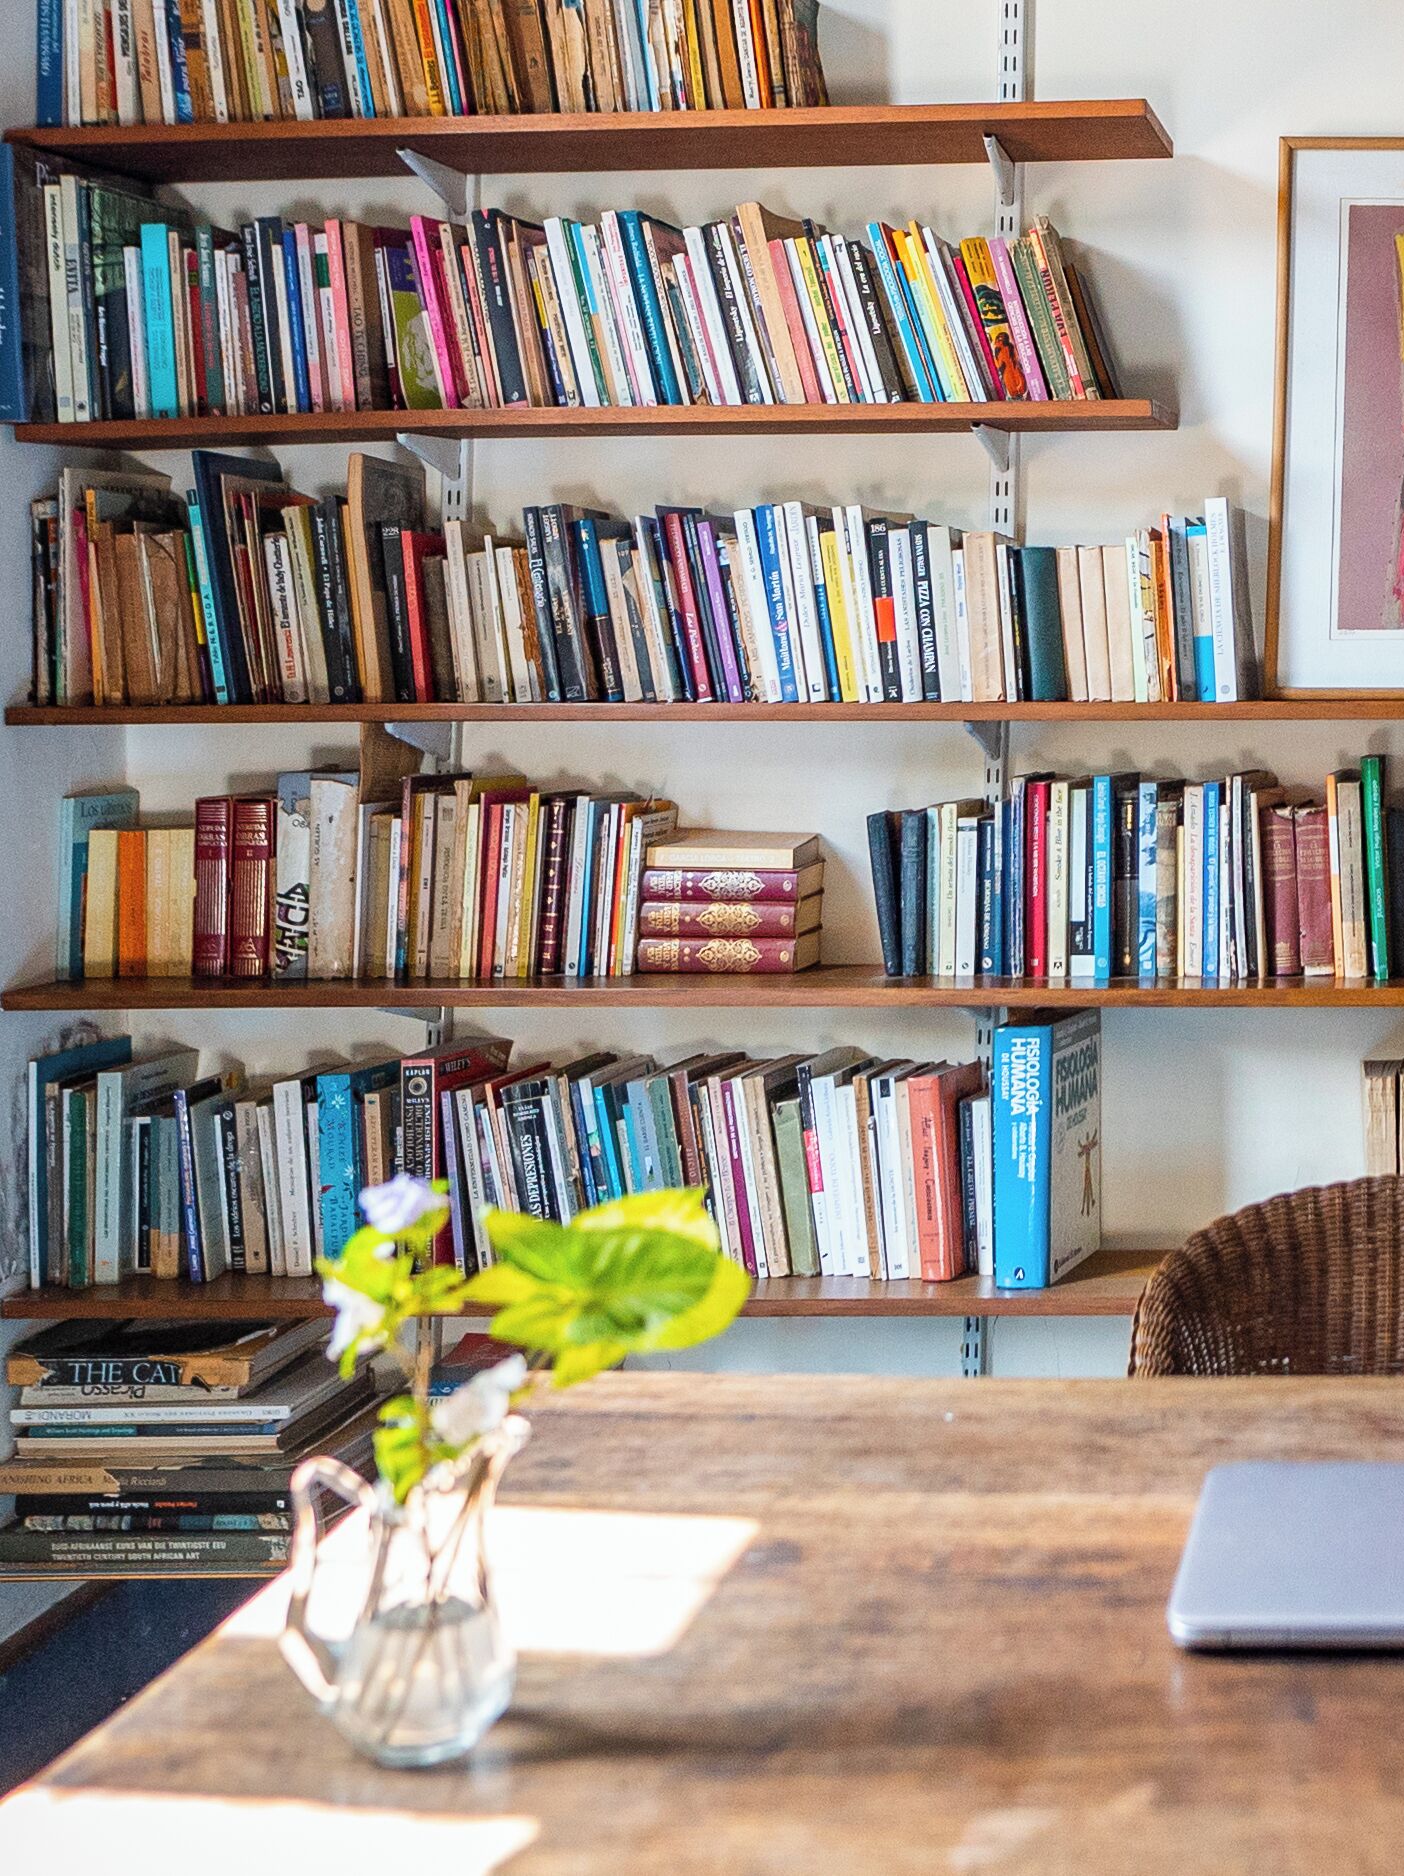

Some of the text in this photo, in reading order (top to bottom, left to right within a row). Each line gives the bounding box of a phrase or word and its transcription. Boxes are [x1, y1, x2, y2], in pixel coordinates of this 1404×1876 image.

[140, 30, 153, 83] Palabras
[352, 306, 362, 327] TAO
[1212, 549, 1221, 594] SHERLOCK
[326, 600, 333, 608] de
[1216, 596, 1222, 607] DE
[203, 593, 216, 644] NERUDA
[918, 581, 935, 673] PIZZA CON CHAMPAN
[1054, 789, 1063, 804] face
[235, 832, 266, 840] OBRAS
[1054, 828, 1063, 845] Blue
[1189, 833, 1198, 844] La
[1054, 856, 1063, 881] Smoke
[1002, 1053, 1009, 1063] DE
[1010, 1037, 1026, 1116] HUMANA
[406, 1105, 415, 1169] PSYCHOLOGY
[521, 1135, 539, 1201] DEPRESIONES
[69, 1363, 181, 1383] THE CAT
[128, 1552, 151, 1560] SOUTH
[138, 1542, 152, 1550] VAN
